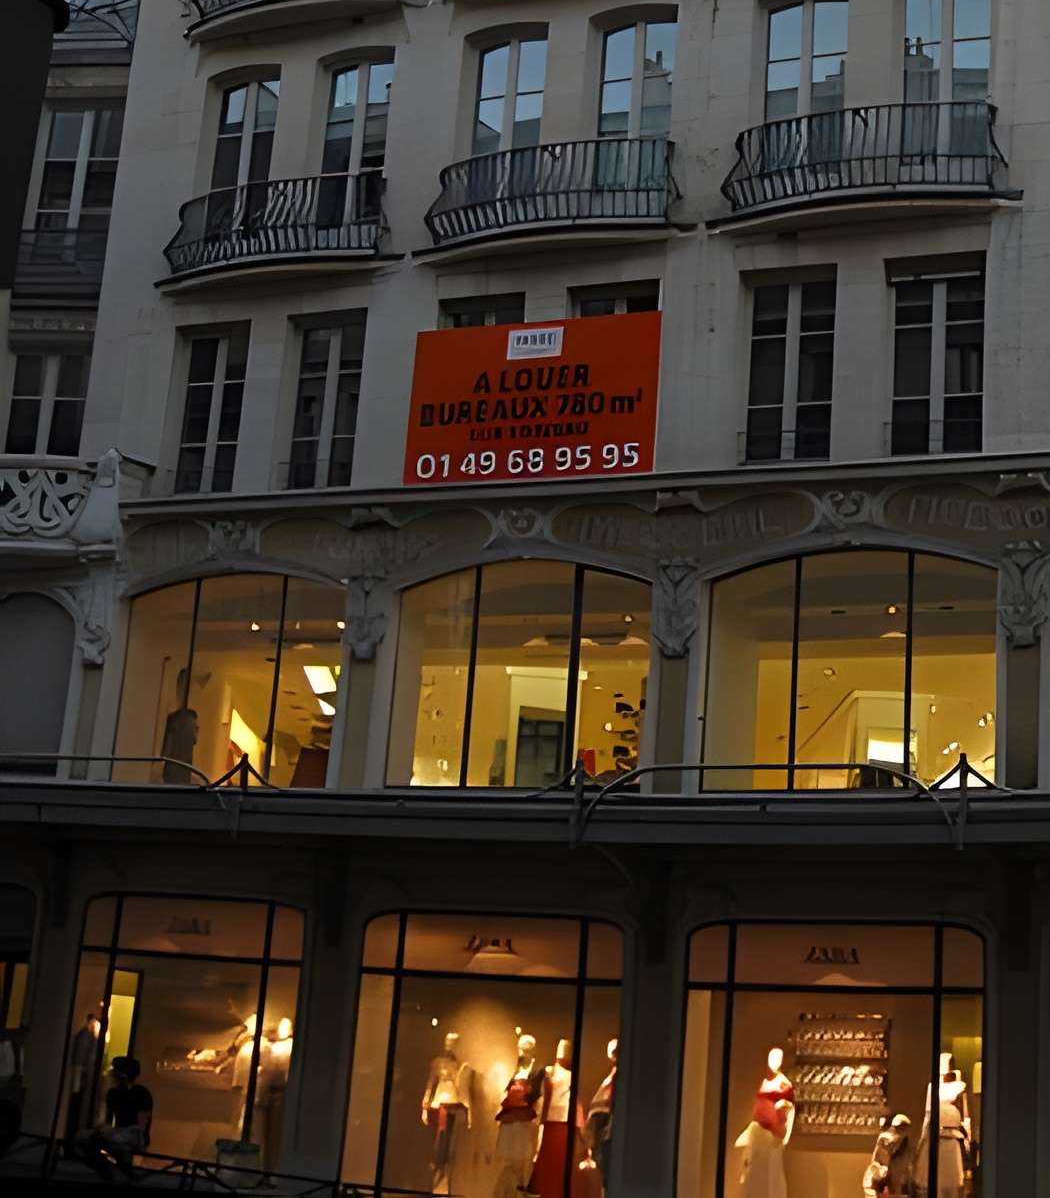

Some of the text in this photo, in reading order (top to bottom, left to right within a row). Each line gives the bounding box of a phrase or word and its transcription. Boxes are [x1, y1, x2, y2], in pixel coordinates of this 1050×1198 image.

[473, 363, 590, 394] A LOUER
[416, 443, 640, 478] 01 49 68 95 95
